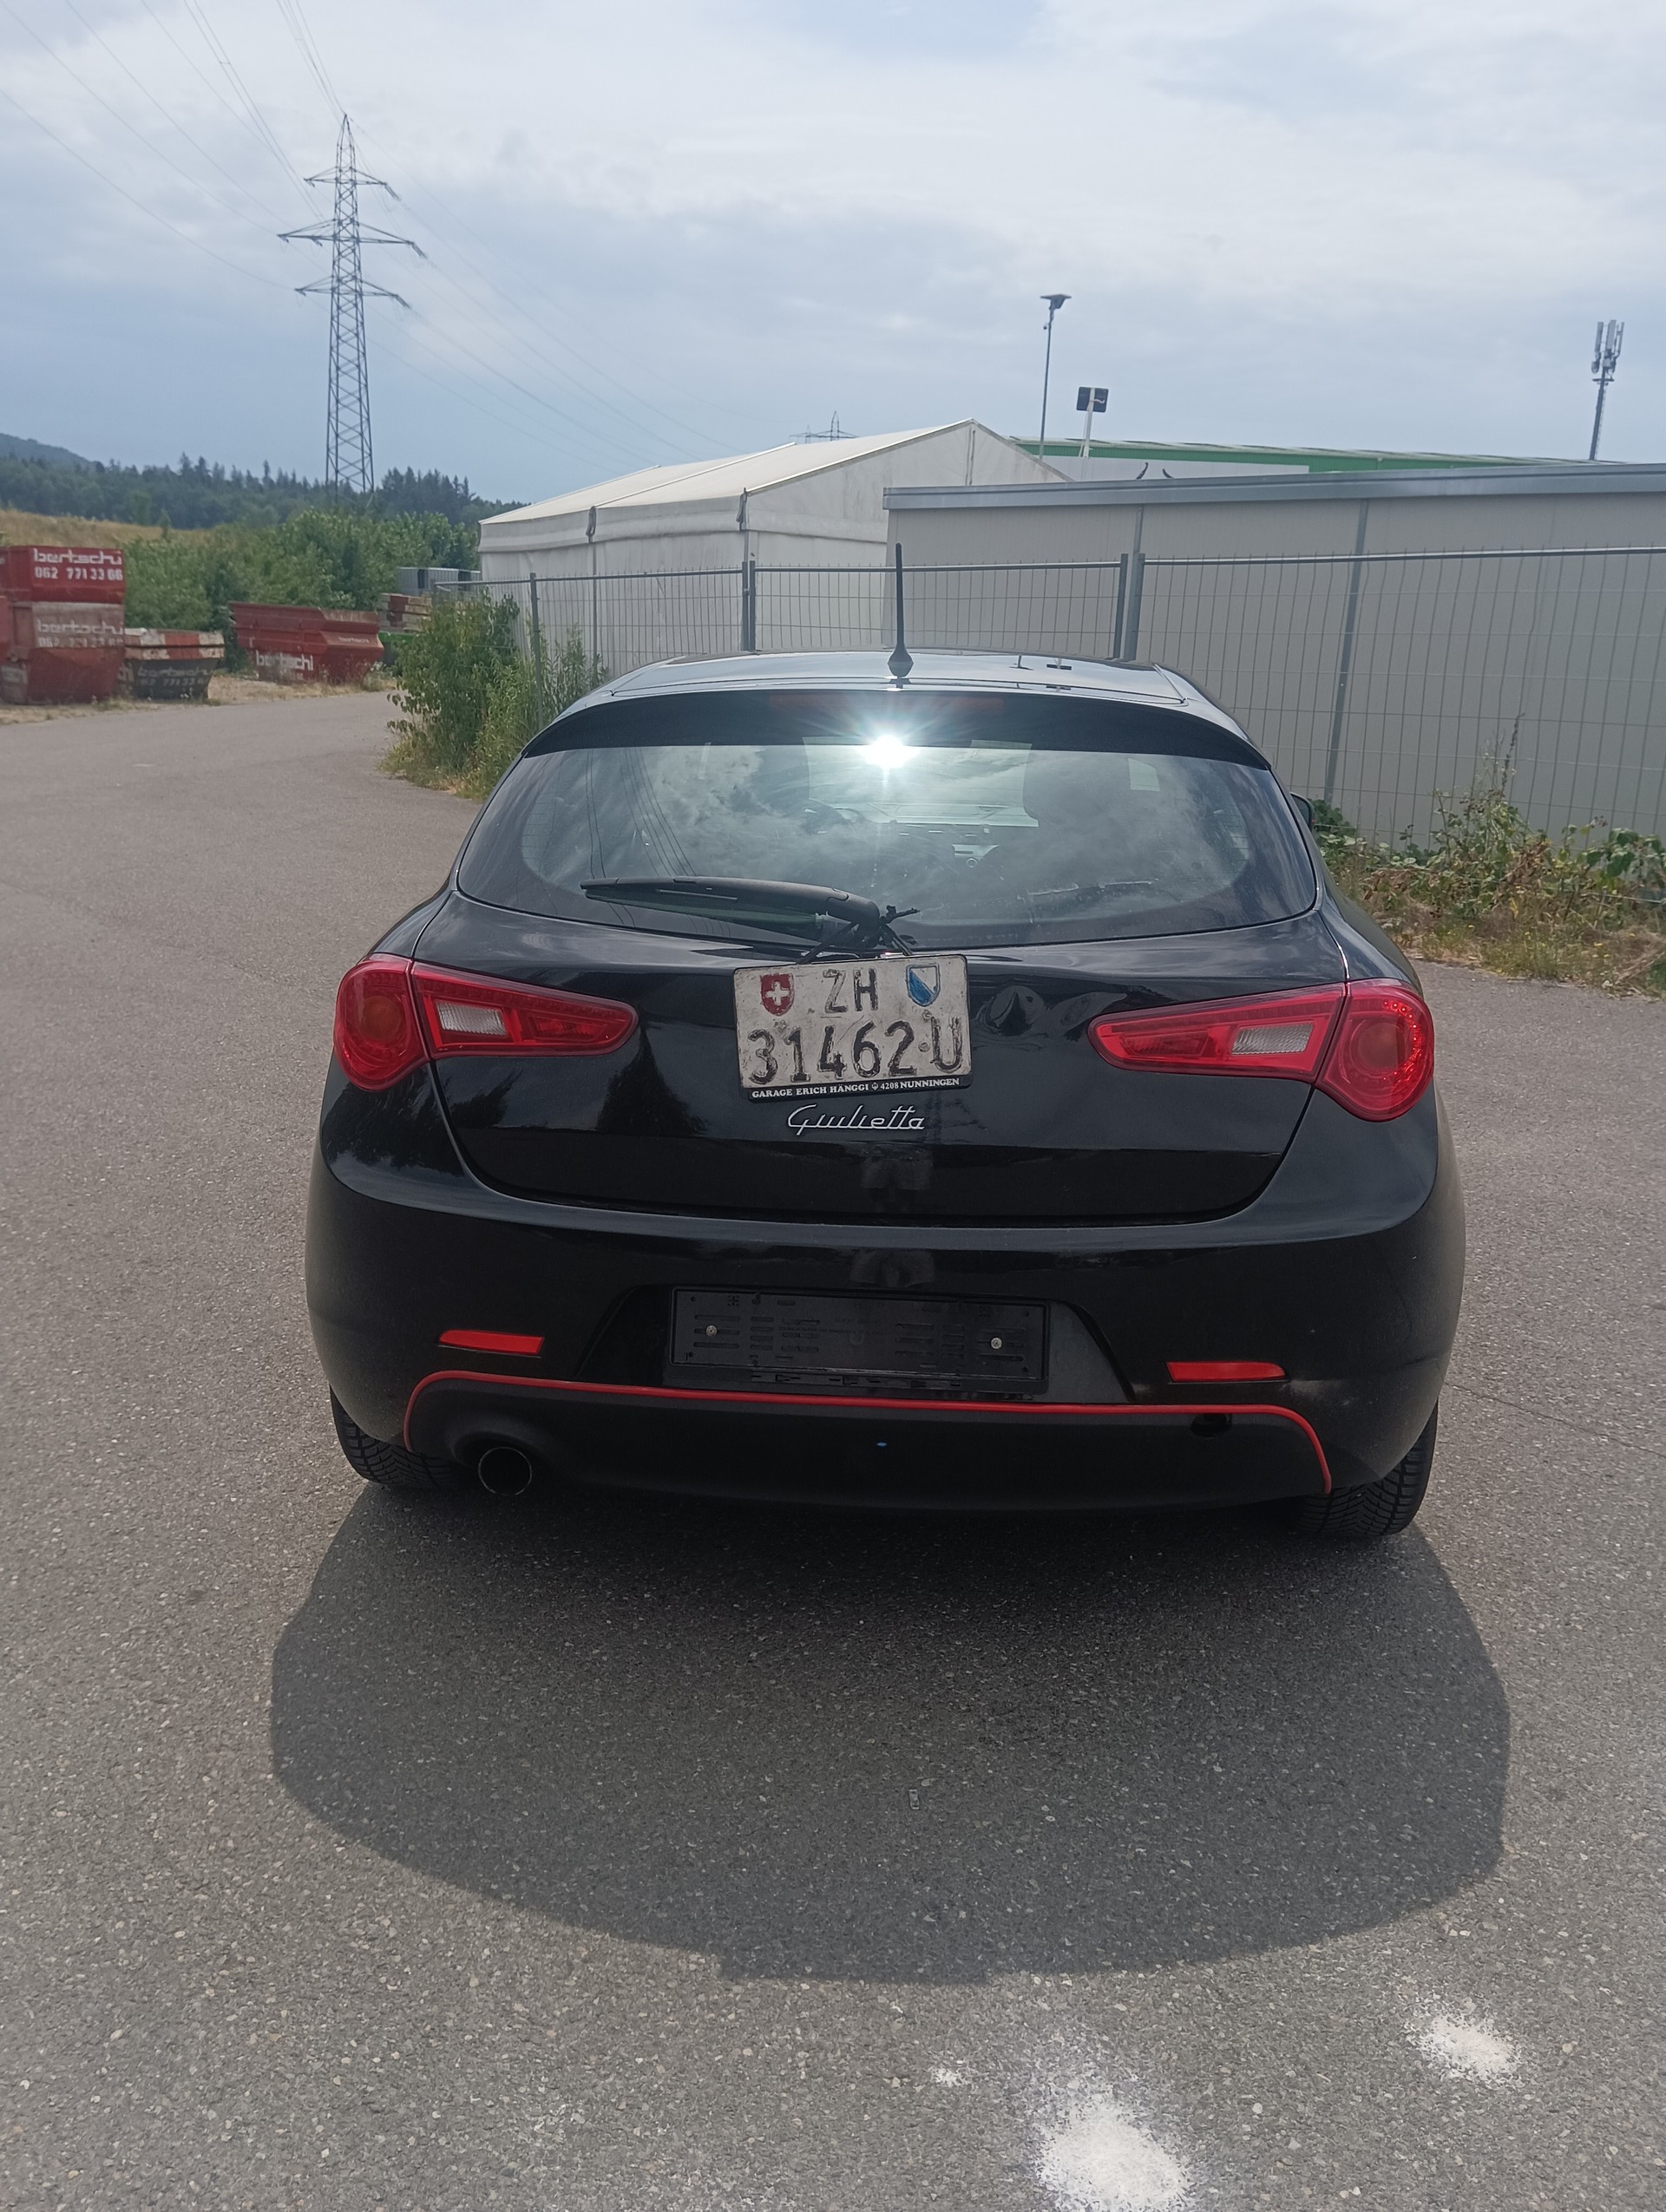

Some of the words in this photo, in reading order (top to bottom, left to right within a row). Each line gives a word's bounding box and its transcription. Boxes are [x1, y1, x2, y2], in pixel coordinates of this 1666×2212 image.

[34, 566, 58, 579] 062
[90, 567, 105, 580] 33
[823, 967, 879, 1013] ZH
[748, 1020, 917, 1084] 31462
[751, 1089, 793, 1098] GARAGE
[796, 1086, 827, 1096] ERICH
[830, 1083, 869, 1094] HÄNGGI
[880, 1081, 899, 1090] 4208
[900, 1078, 960, 1090] NUNNINGEN
[787, 1103, 926, 1135] Giulietta
